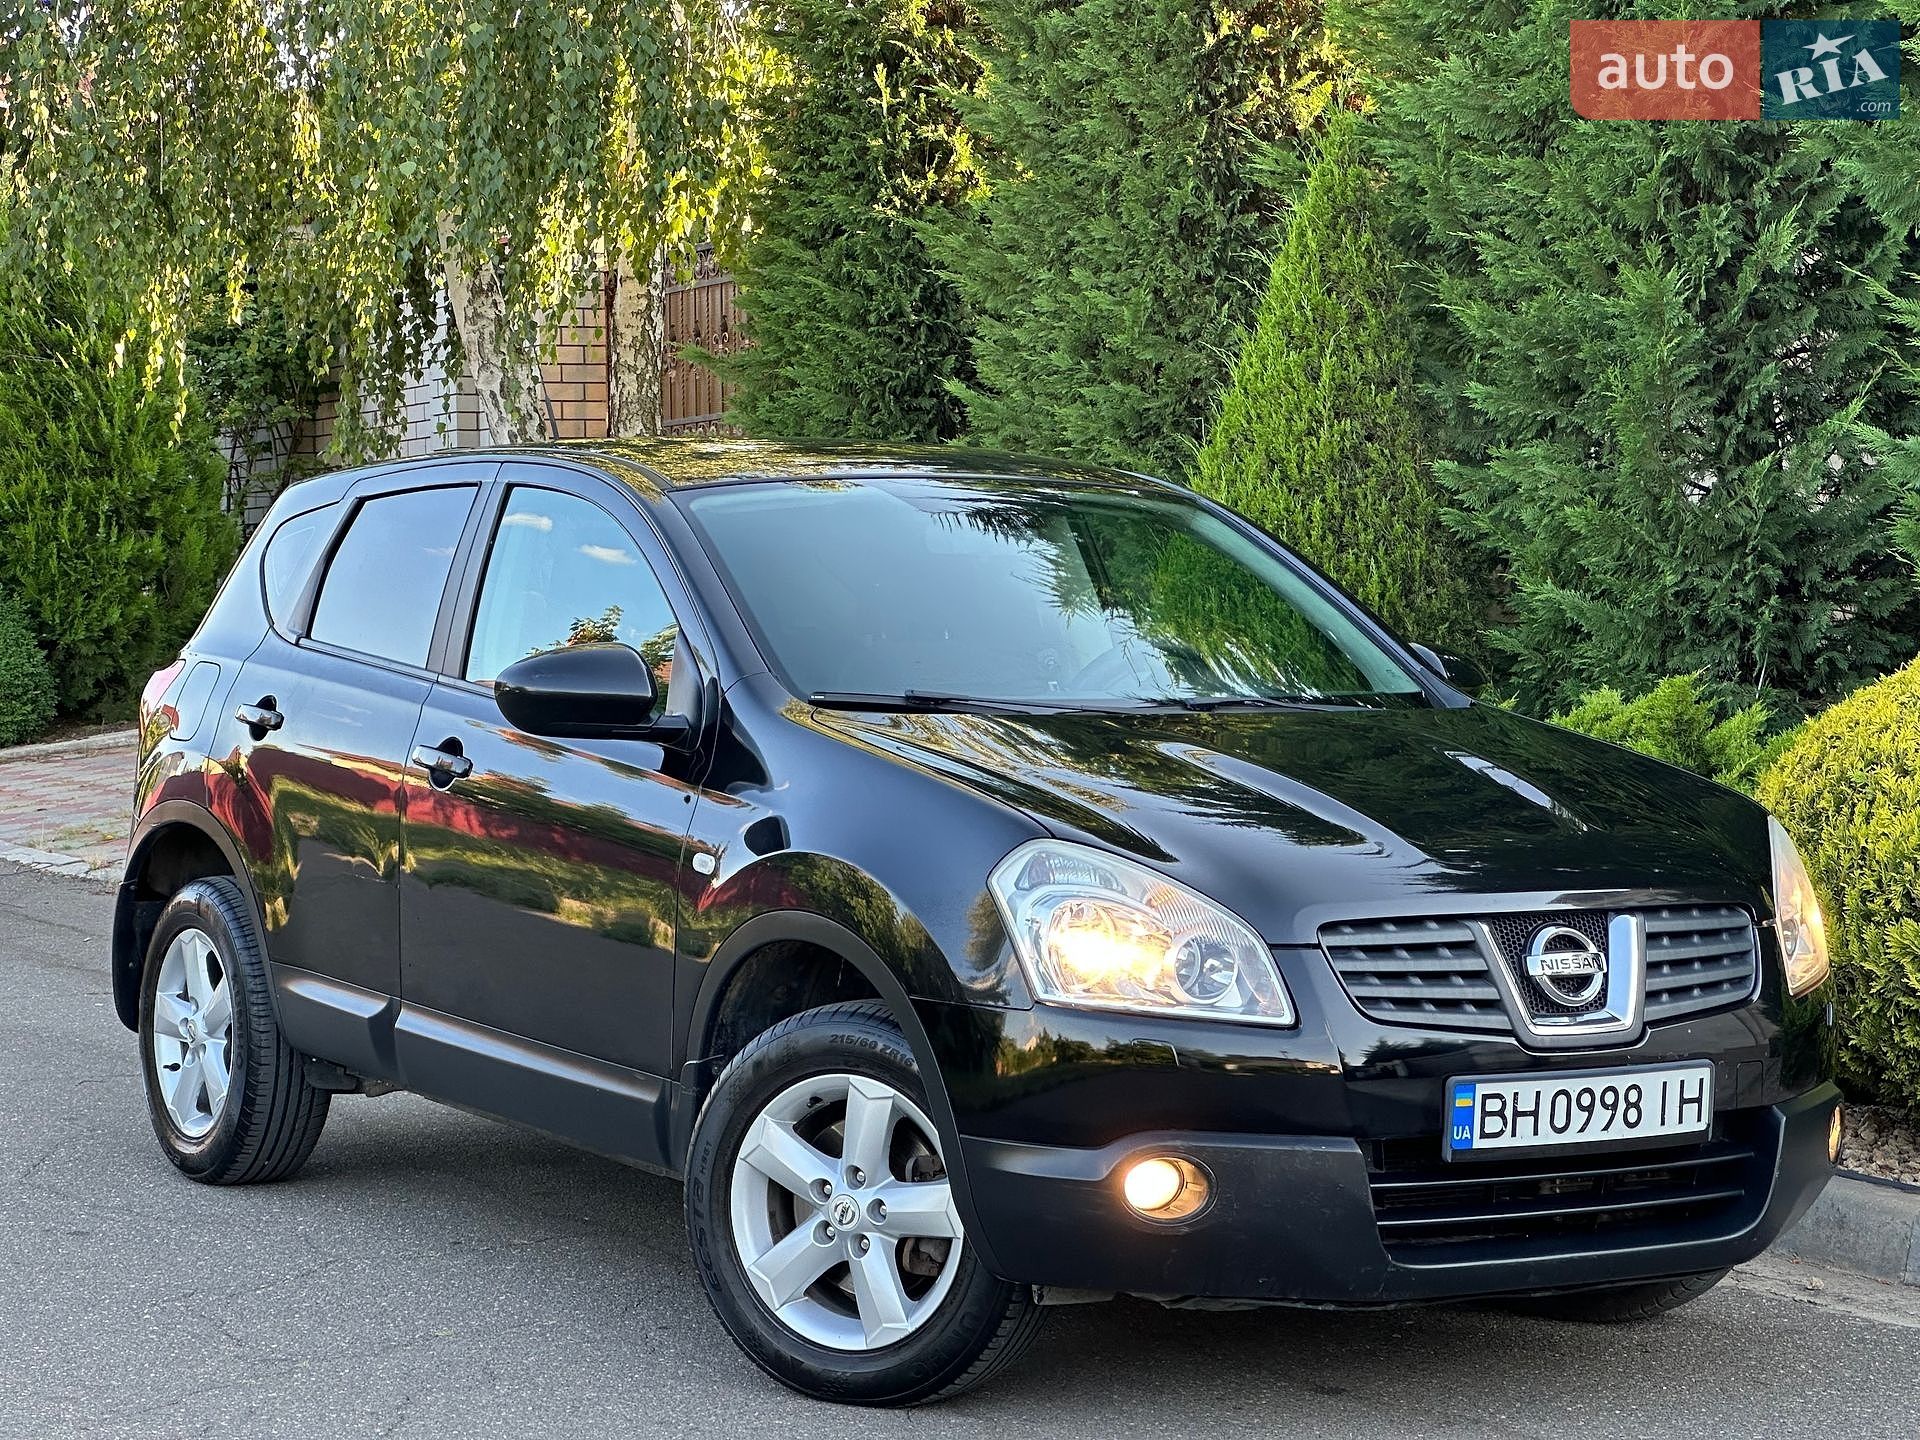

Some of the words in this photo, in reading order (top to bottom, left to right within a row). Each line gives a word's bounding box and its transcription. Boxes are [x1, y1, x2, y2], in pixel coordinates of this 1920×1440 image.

[1540, 956, 1605, 971] NISSAN
[829, 1033, 879, 1050] 215/60
[1453, 1125, 1471, 1141] UA
